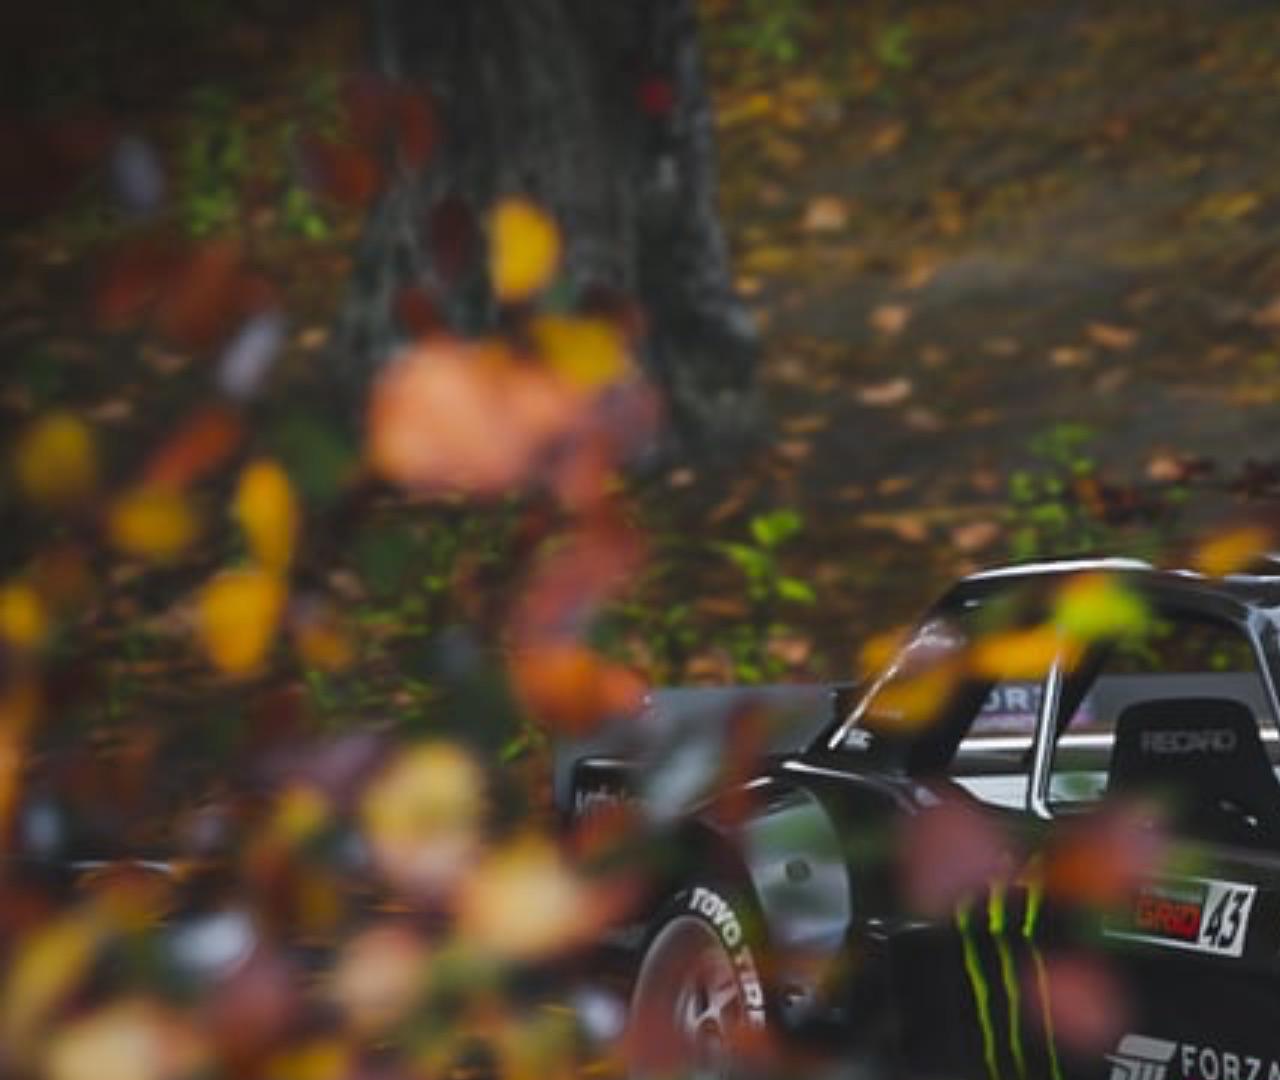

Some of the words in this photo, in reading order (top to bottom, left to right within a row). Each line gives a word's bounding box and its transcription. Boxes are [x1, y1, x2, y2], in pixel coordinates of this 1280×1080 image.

[1140, 729, 1238, 753] RECARO
[1203, 889, 1250, 950] 43
[689, 887, 742, 947] TOYO
[734, 945, 766, 1032] TIRE
